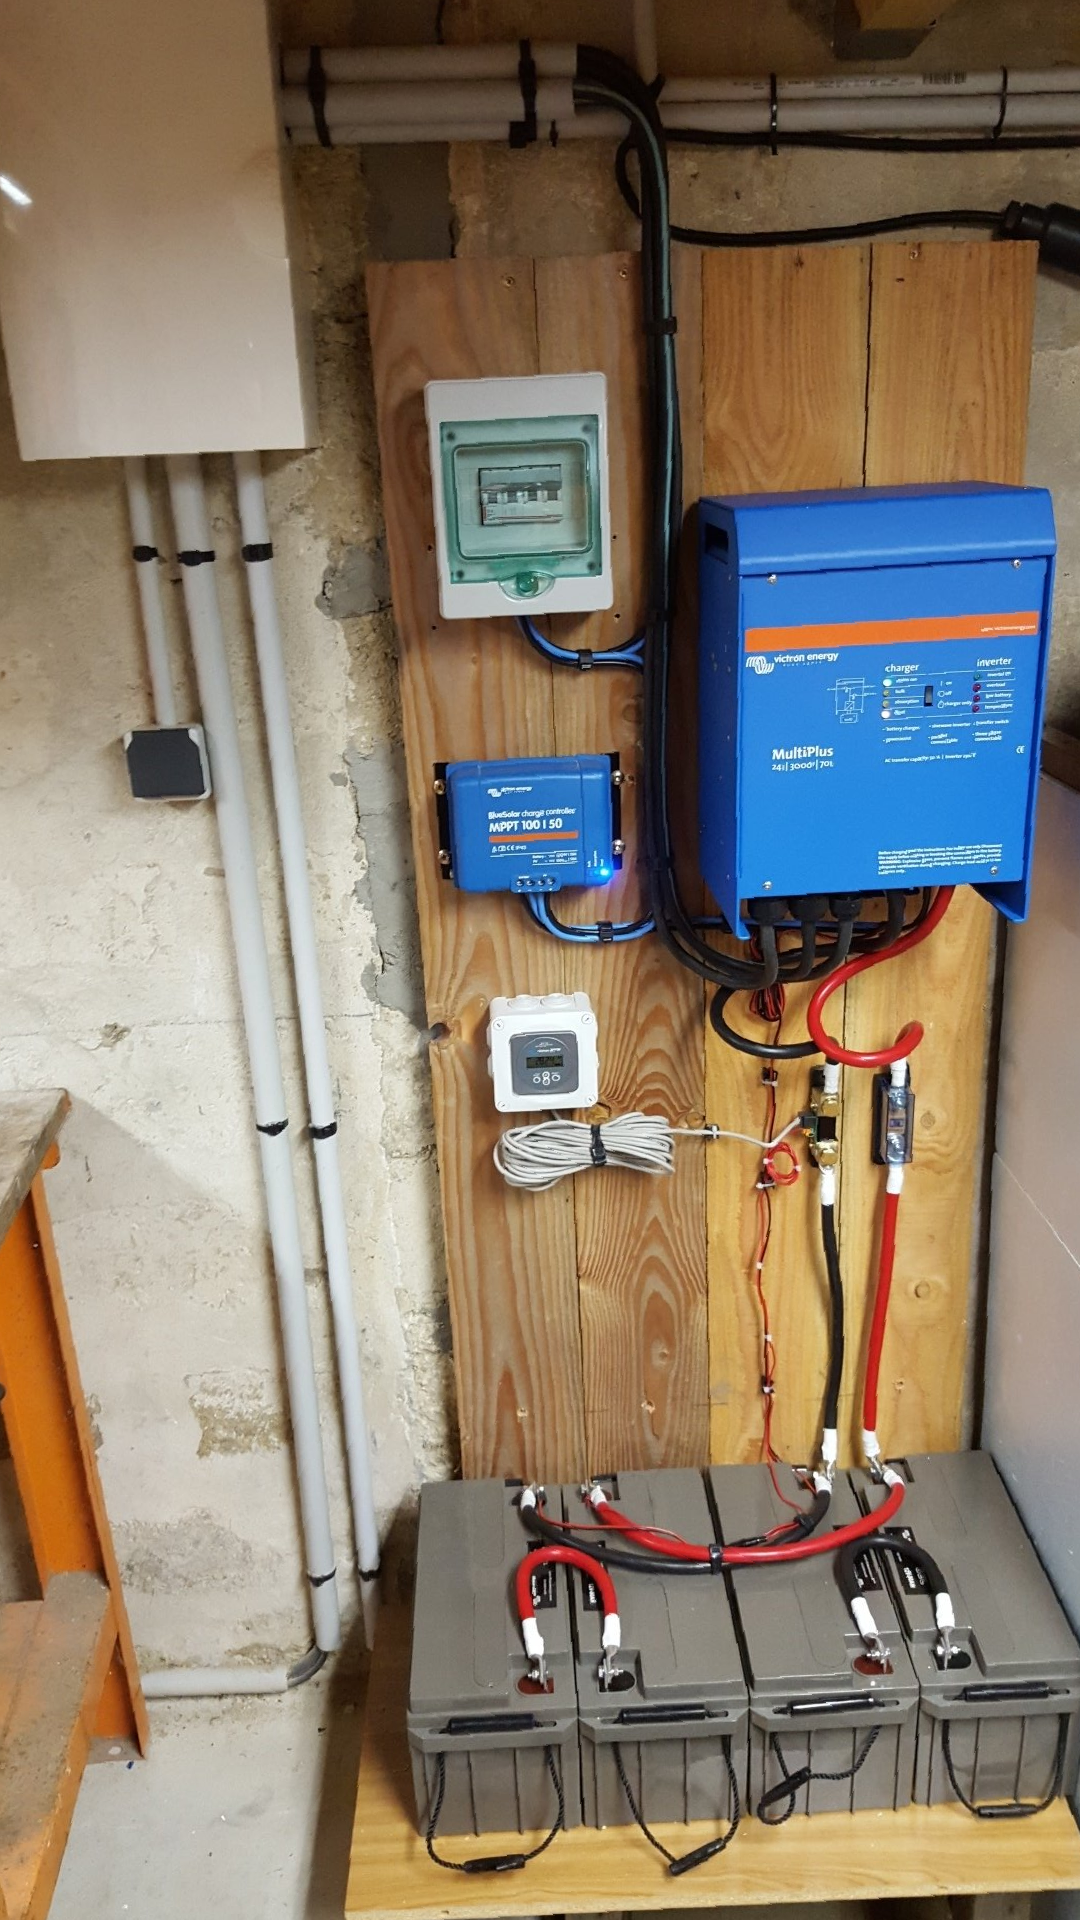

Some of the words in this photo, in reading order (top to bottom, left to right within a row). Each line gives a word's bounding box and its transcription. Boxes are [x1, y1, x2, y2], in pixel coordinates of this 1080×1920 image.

[774, 654, 805, 663] victron
[807, 653, 839, 662] energy
[977, 657, 1012, 667] inverter
[885, 664, 919, 674] charger
[772, 746, 834, 760] MultiPlus
[488, 811, 520, 819] BlueSolar
[521, 810, 544, 818] charge
[546, 807, 576, 816] controller
[489, 821, 519, 832] MPPT
[522, 820, 540, 830] 100
[549, 818, 562, 829] 50
